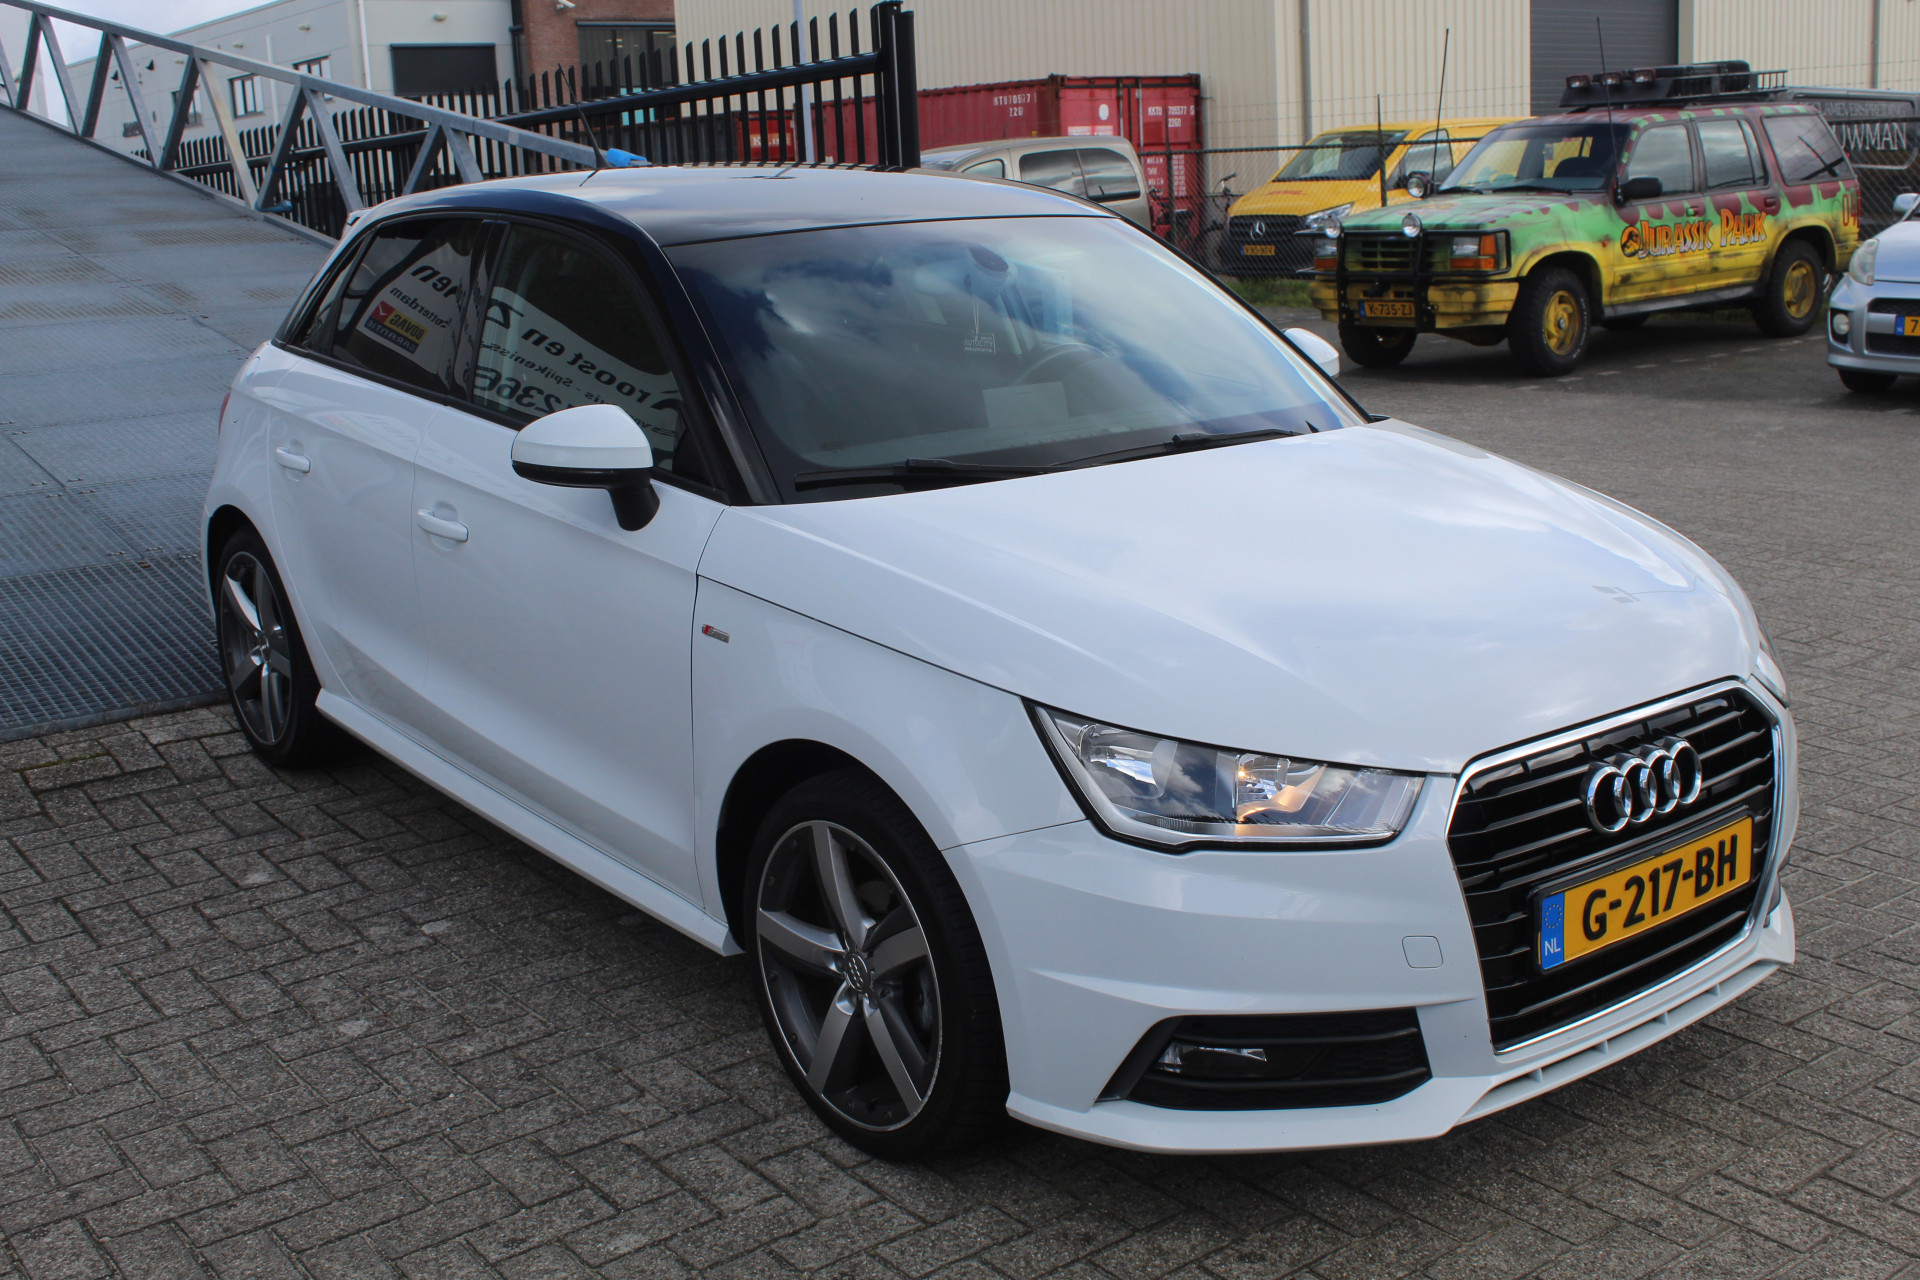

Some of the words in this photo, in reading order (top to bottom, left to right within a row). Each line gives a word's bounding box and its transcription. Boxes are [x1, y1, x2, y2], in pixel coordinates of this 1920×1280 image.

[1638, 220, 1714, 259] JURASSIC
[1720, 208, 1768, 247] PARK
[1368, 303, 1413, 316] K-735-ZJ
[1583, 834, 1738, 941] G-217-BH
[1544, 937, 1561, 956] NL
